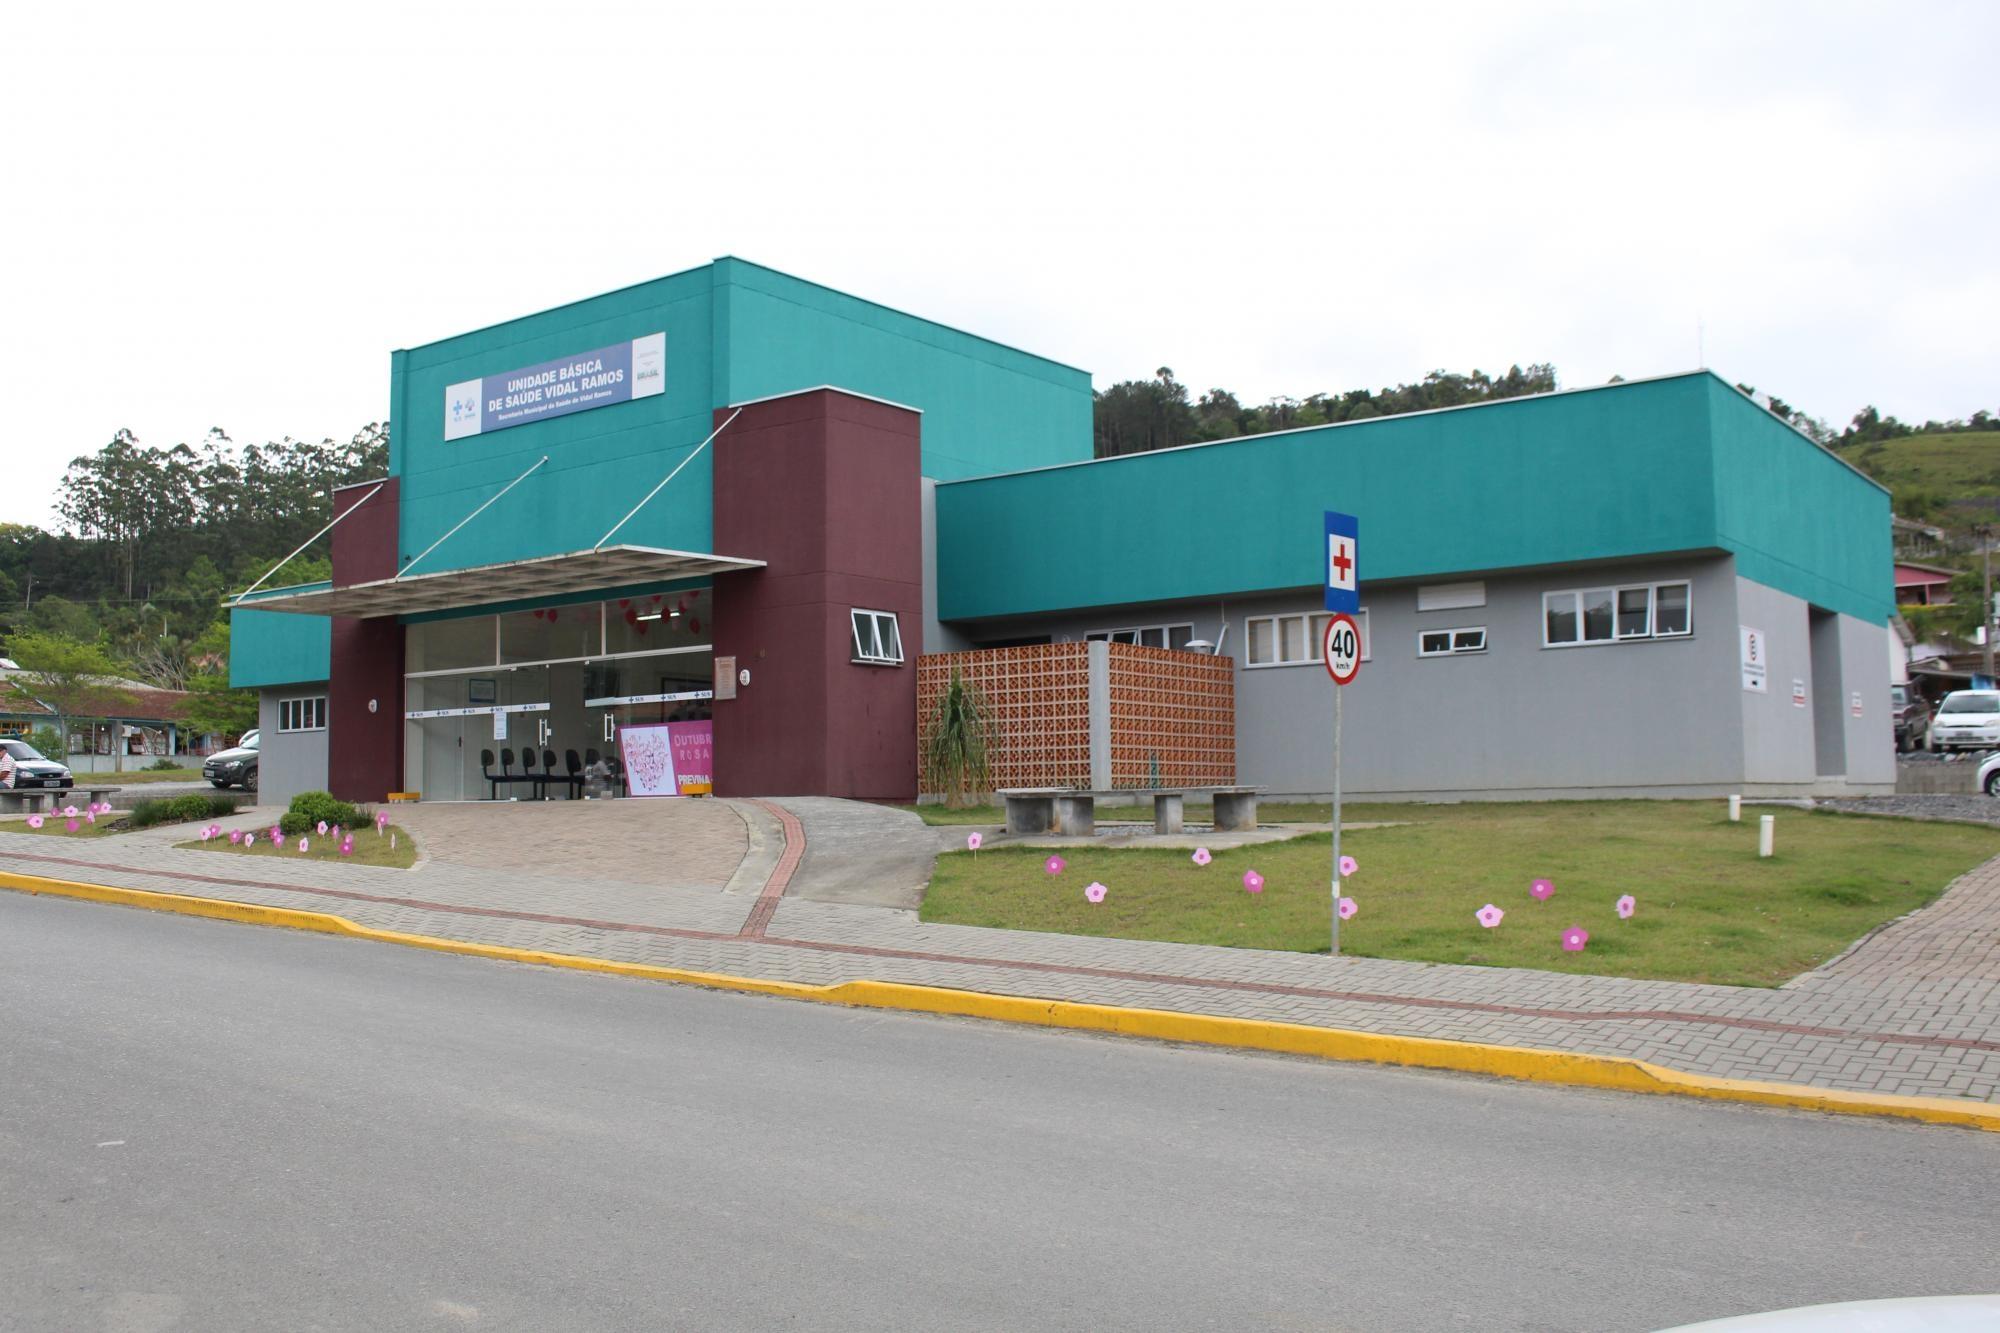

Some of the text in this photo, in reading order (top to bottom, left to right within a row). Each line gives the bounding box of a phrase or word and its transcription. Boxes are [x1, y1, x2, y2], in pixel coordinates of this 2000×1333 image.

[489, 369, 624, 412] DE SAÚDE VIDAL RAMOS
[508, 359, 602, 393] UNIDADE BÁSICA
[1332, 630, 1354, 659] 40
[1336, 662, 1350, 670] km/h
